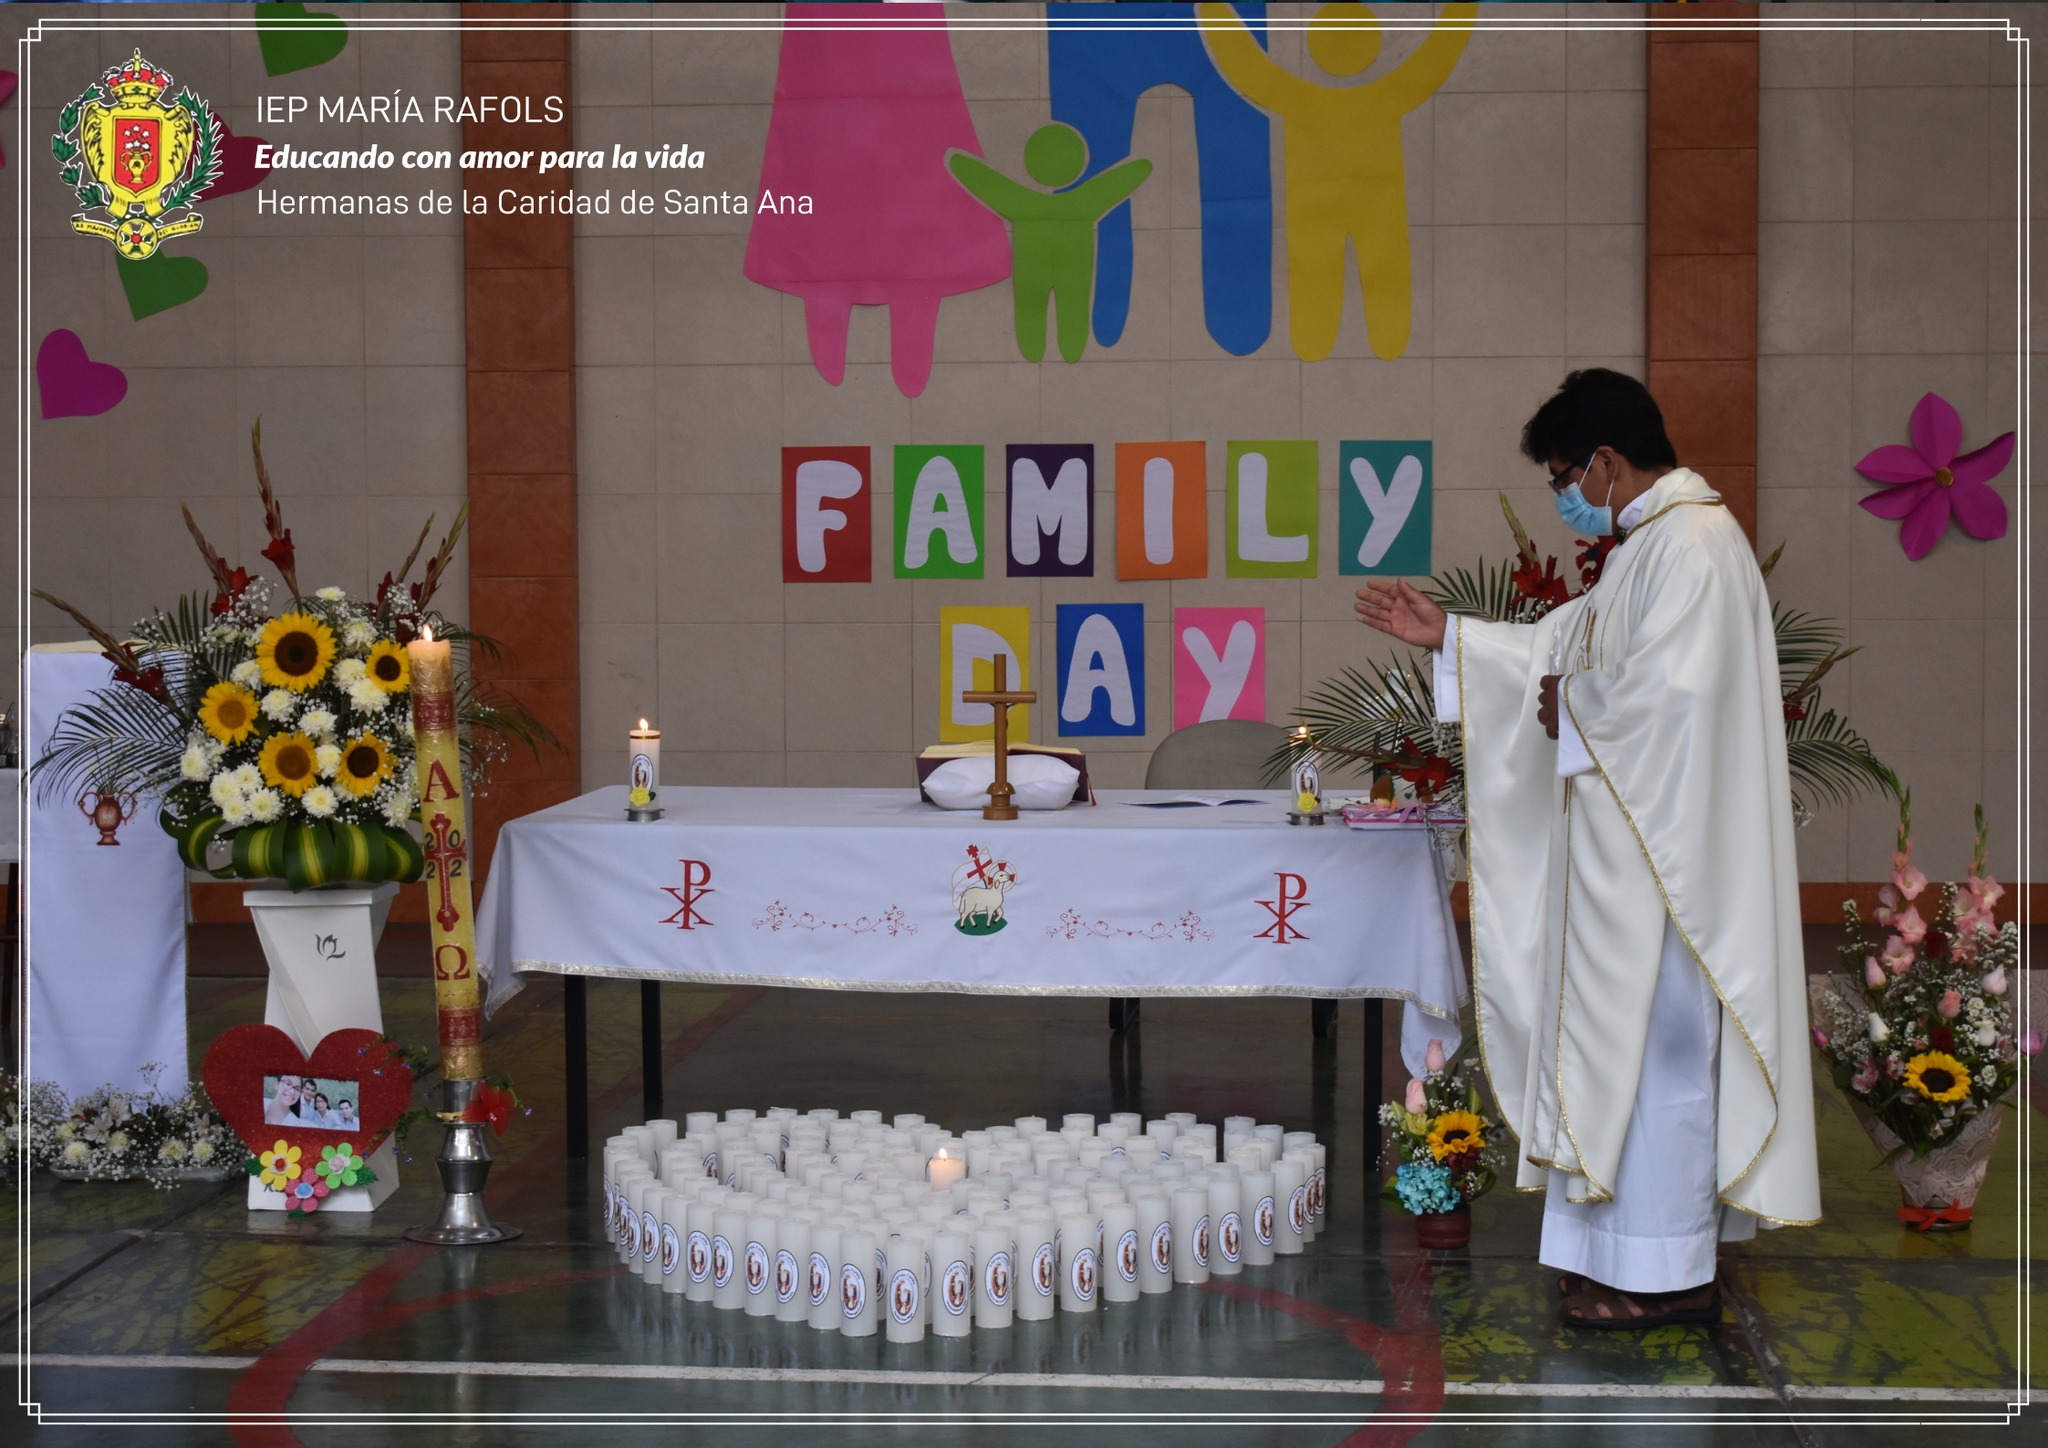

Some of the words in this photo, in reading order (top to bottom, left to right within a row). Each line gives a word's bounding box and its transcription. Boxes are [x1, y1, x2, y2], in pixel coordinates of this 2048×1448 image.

[796, 452, 1423, 573] FAMILY
[951, 613, 1256, 727] DAY
[435, 945, 471, 980] Ω
